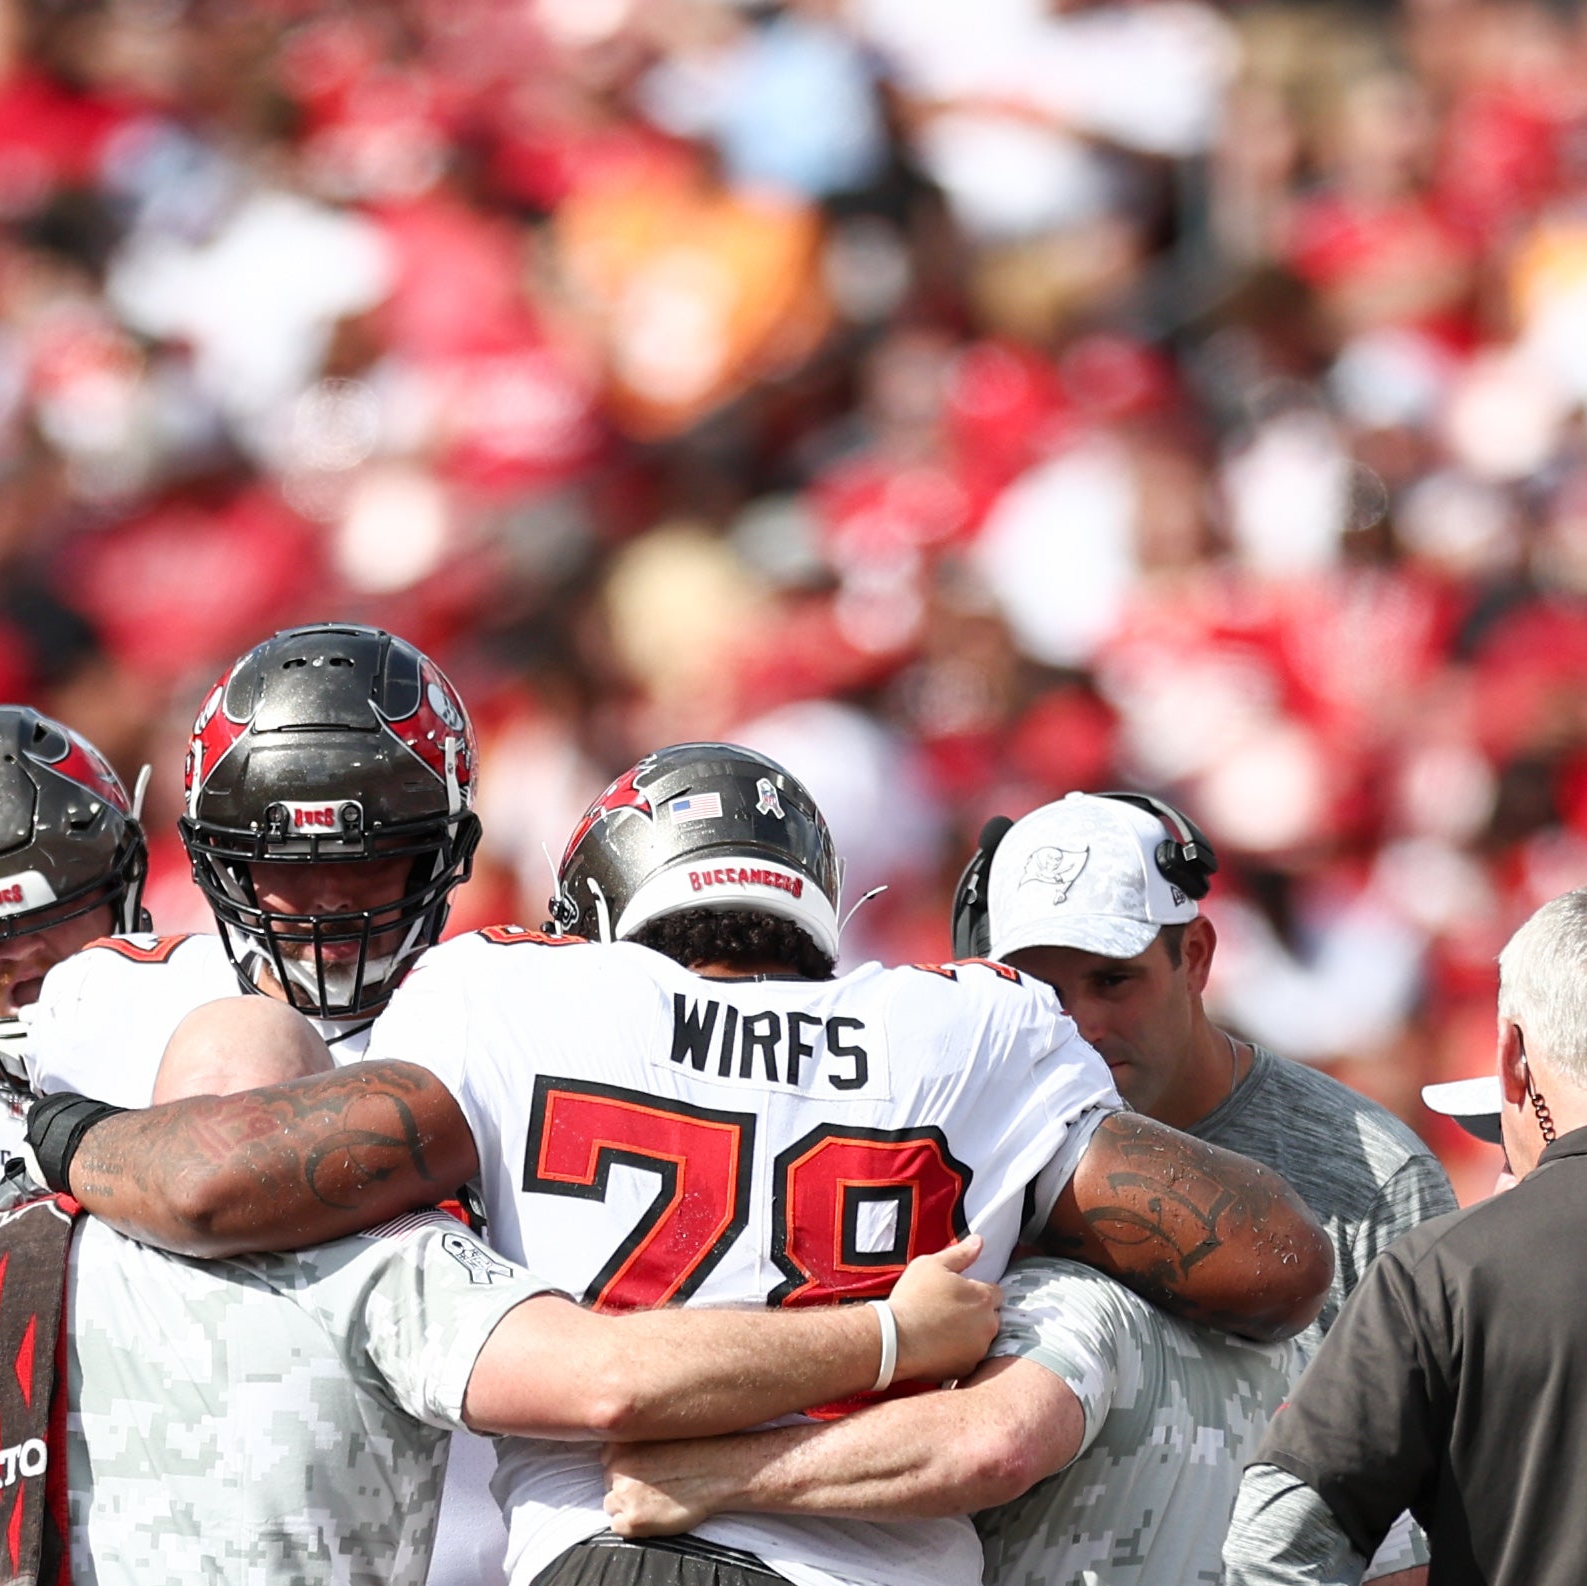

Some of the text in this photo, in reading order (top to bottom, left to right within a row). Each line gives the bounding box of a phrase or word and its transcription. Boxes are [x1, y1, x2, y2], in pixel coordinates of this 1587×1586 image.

[294, 806, 335, 828] BUCS
[688, 867, 803, 899] BUCCANEERS
[670, 992, 869, 1091] WIRFS
[522, 1073, 973, 1419] 78
